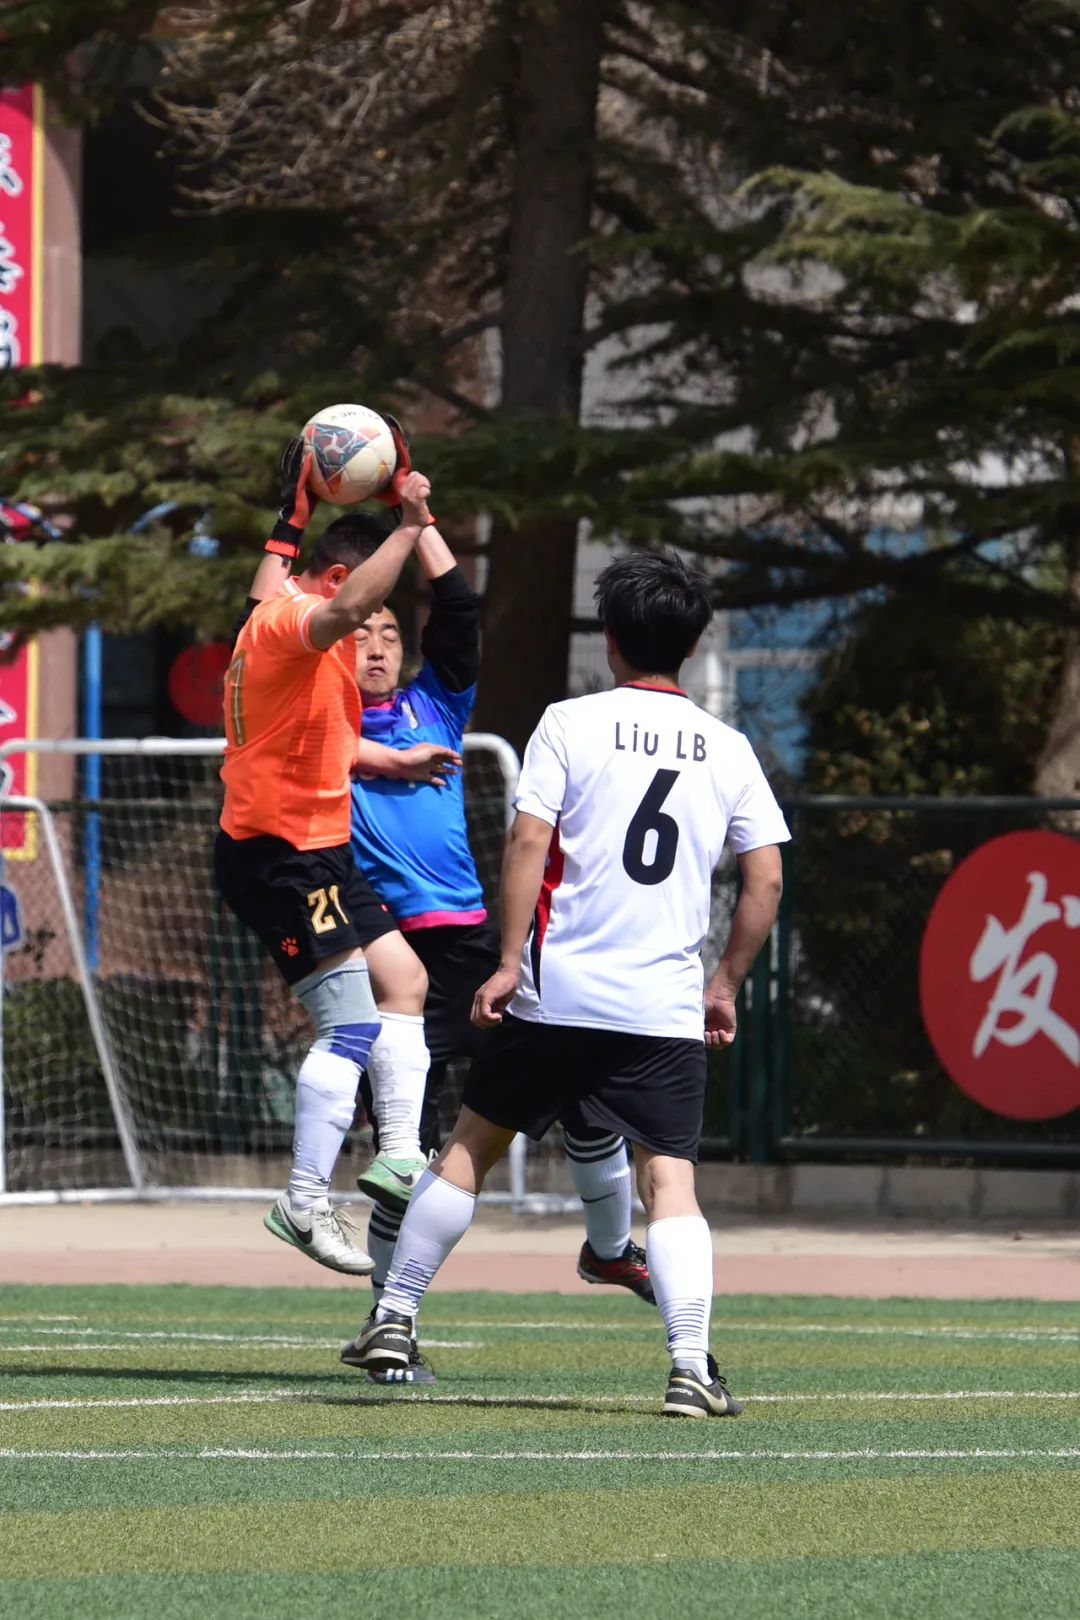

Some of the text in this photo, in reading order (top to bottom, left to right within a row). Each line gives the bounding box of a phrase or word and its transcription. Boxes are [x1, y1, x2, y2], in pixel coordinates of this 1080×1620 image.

[615, 721, 707, 762] Liu LB
[622, 767, 681, 886] 6
[307, 884, 350, 935] 21
